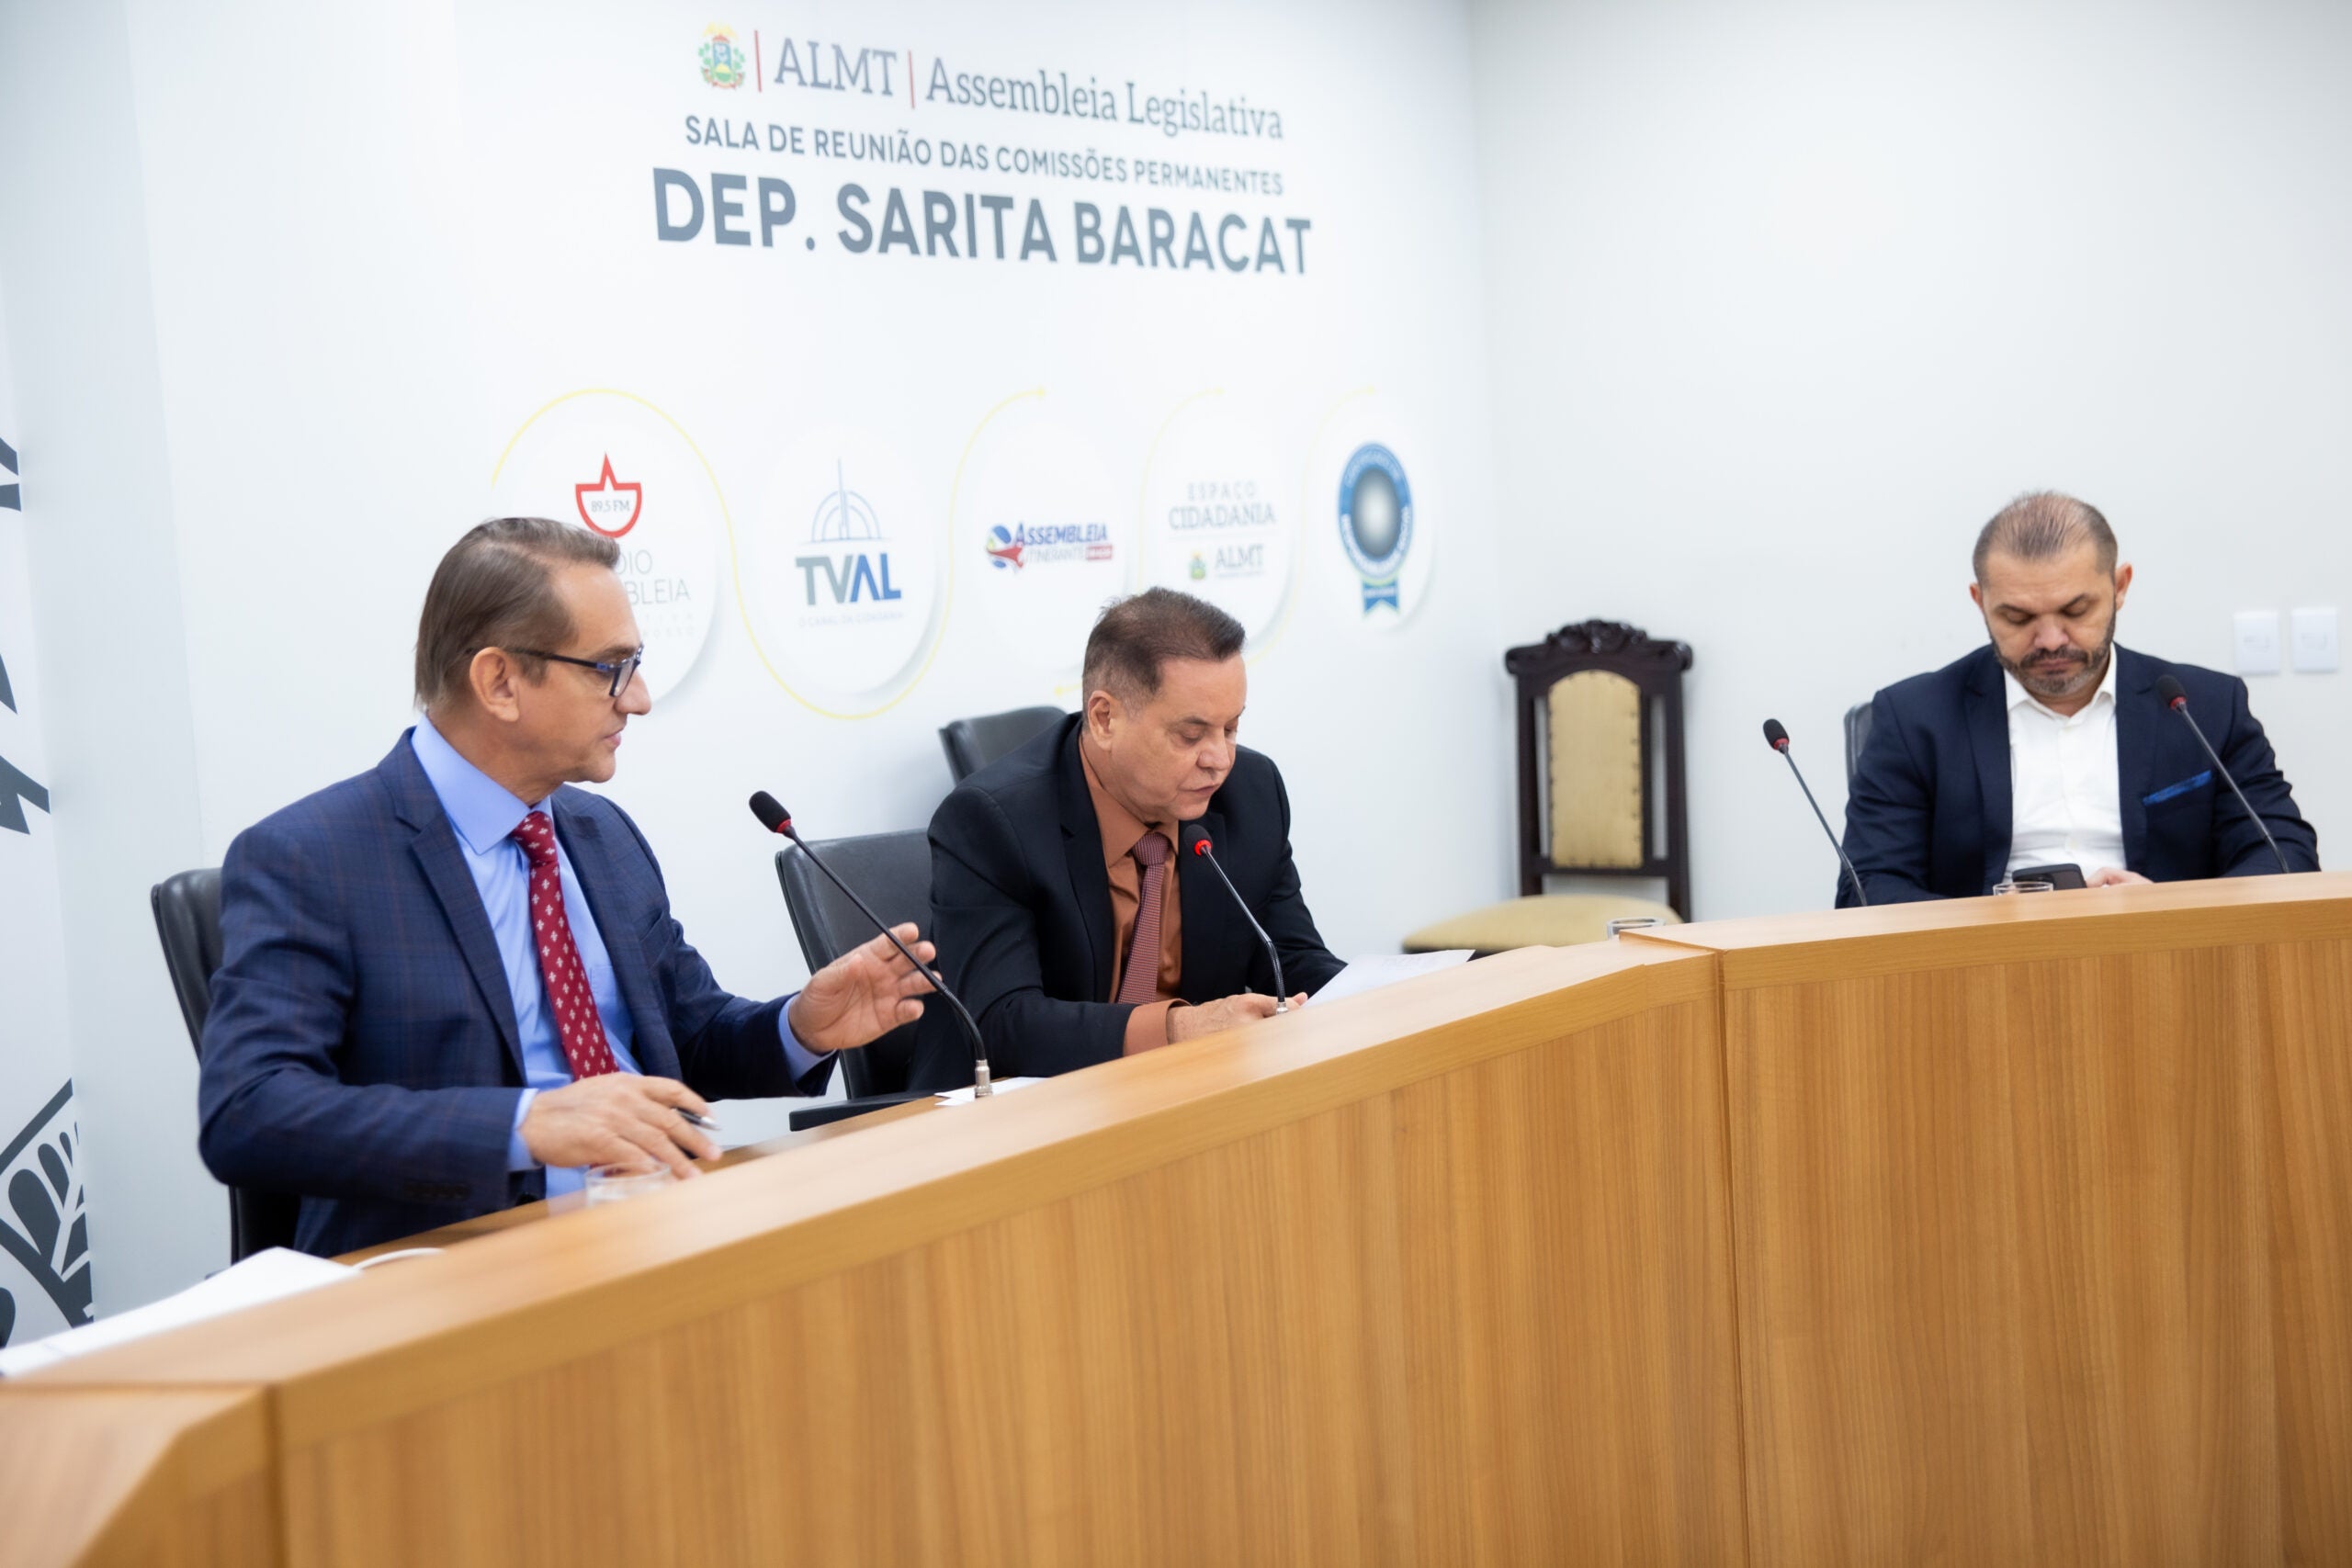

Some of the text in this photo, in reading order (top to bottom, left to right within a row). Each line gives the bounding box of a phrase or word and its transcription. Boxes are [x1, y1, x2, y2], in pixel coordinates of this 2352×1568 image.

[774, 37, 1283, 140] ALMT Assembleia Legislativa
[684, 115, 1283, 196] SALA DE REUNIÃO DAS COMISSÕES PERMANENTES
[652, 167, 1312, 275] DEP. SARITA BARACAT
[1014, 522, 1108, 546] ASSEMBLEIA
[1168, 503, 1276, 530] CIDADANIA
[796, 553, 901, 605] TVAL
[1215, 543, 1265, 569] ALMT
